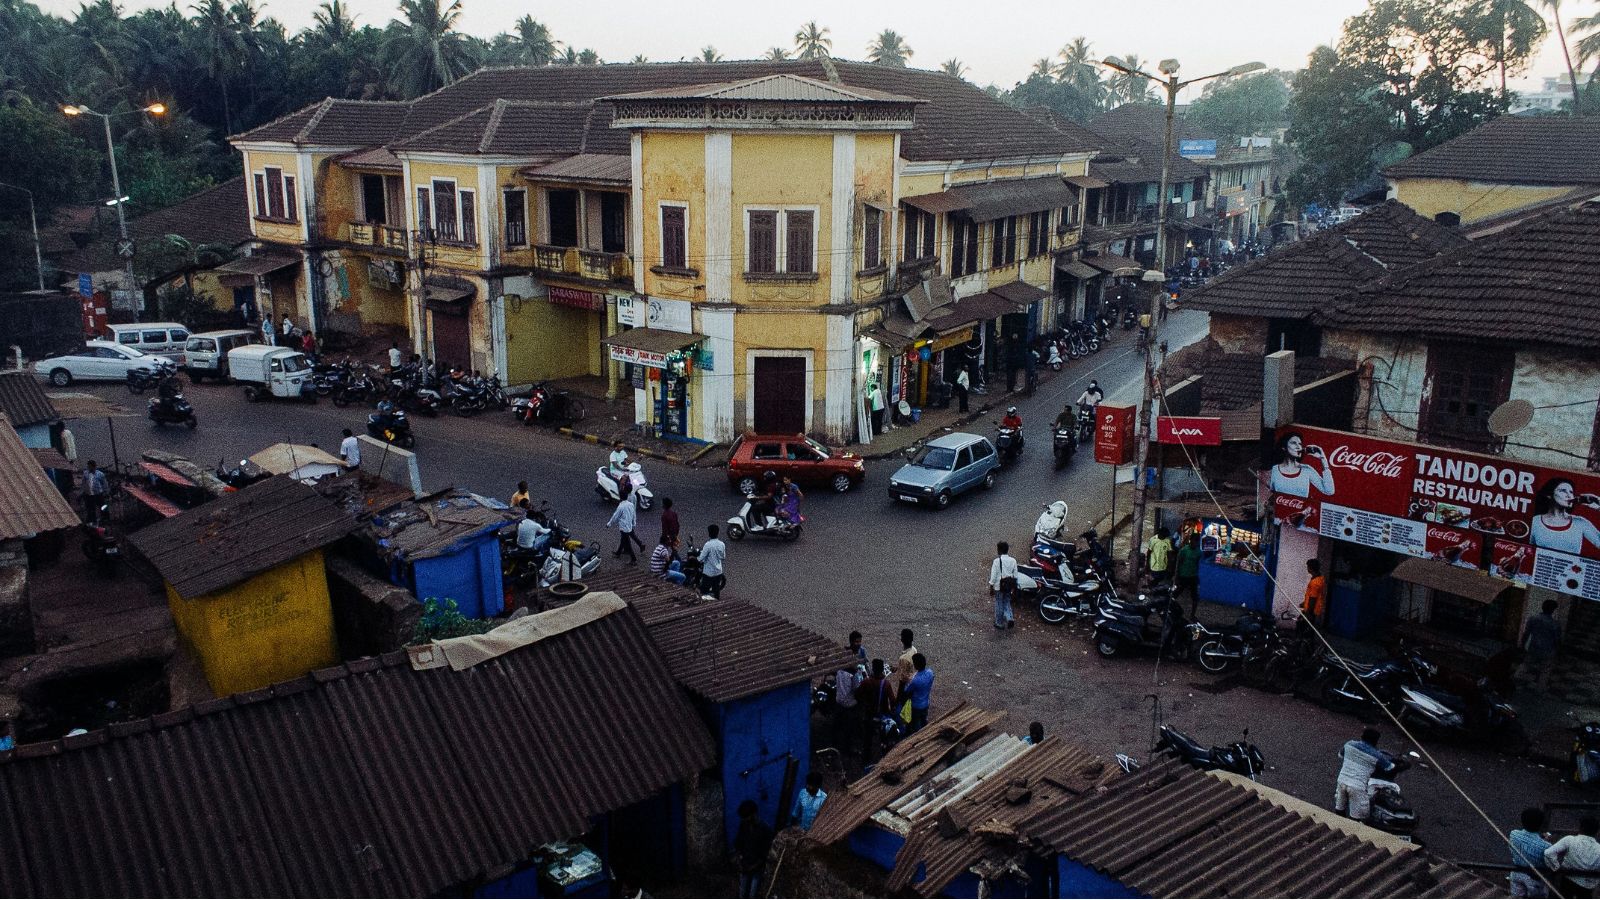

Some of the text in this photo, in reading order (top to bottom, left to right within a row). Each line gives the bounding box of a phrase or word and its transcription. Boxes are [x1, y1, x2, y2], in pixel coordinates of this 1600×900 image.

[551, 287, 591, 302] SARASWATI
[619, 298, 630, 307] NEW
[1101, 423, 1117, 432] airtel
[1171, 427, 1204, 436] LAVA
[1329, 445, 1408, 478] Coca-Cola
[1415, 454, 1535, 494] TANDOOR
[1276, 496, 1304, 509] Coca-Cola
[1413, 478, 1532, 513] RESTAURANT
[1427, 527, 1461, 543] Coca-Cola
